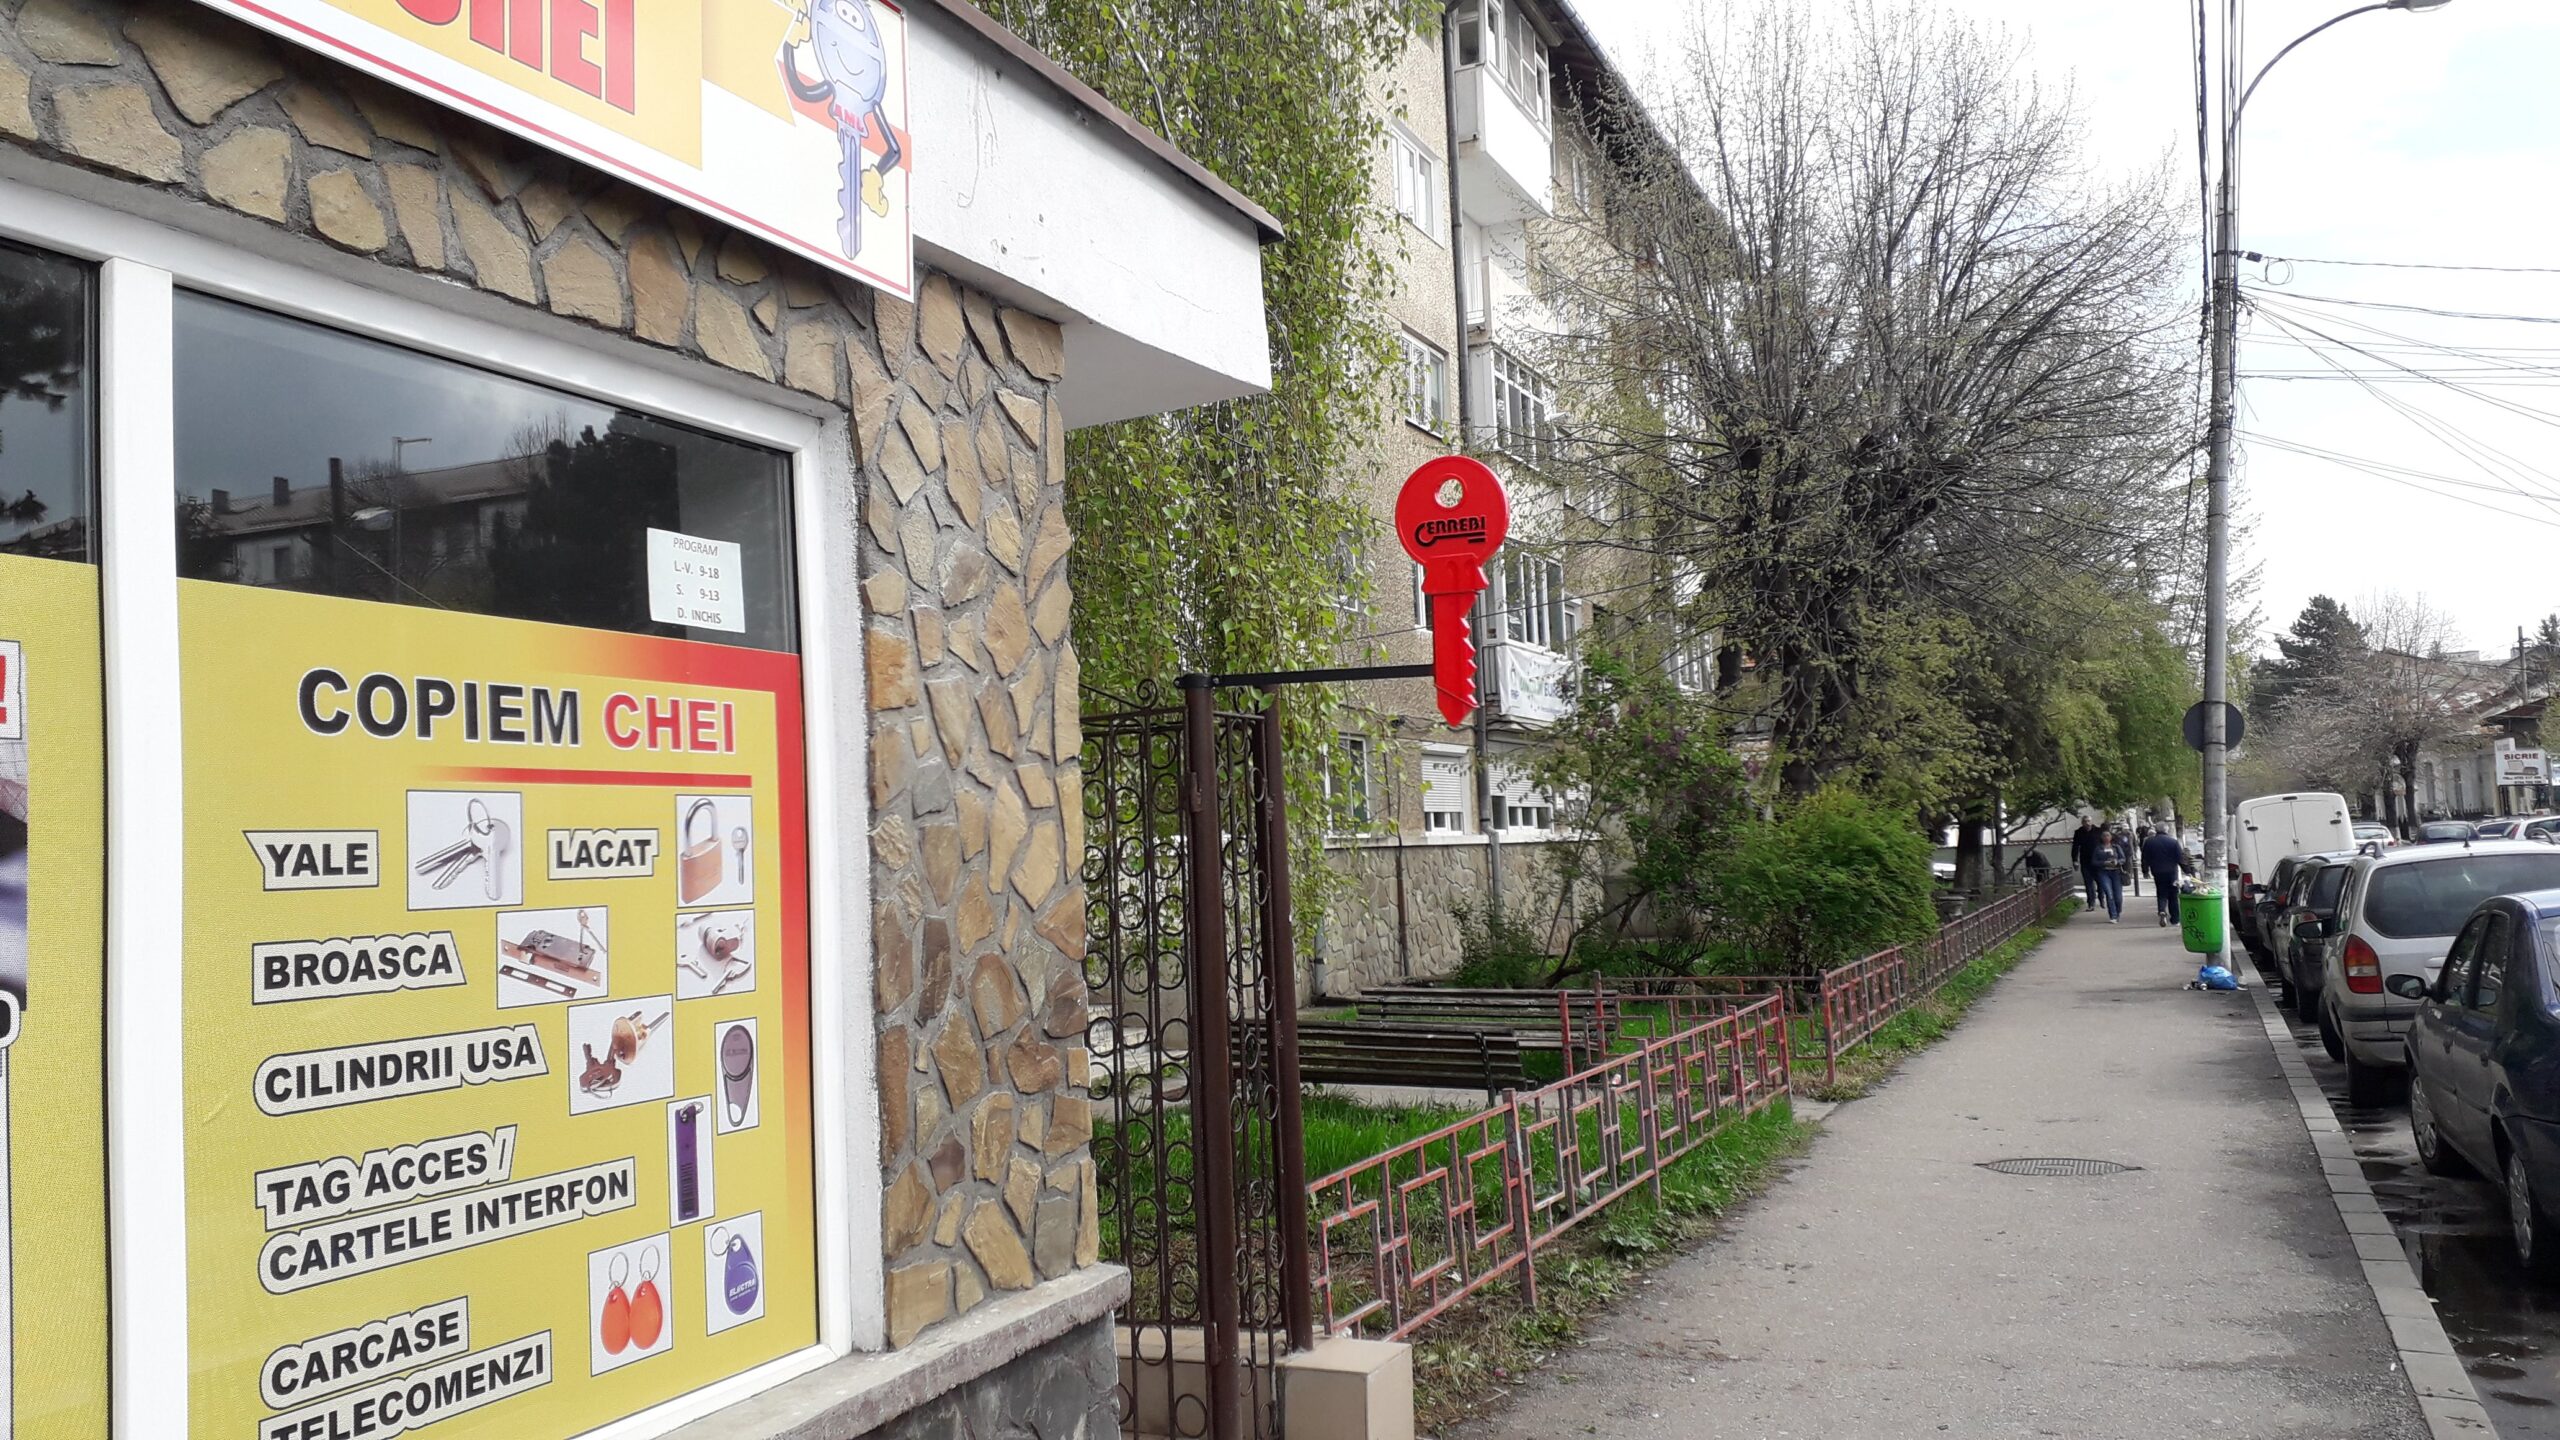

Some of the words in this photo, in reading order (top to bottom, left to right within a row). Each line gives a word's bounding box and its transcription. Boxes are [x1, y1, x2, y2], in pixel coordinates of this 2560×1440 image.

[673, 538, 718, 556] PROGRAM
[674, 560, 694, 575] L-V.
[699, 565, 720, 579] 9-18
[676, 584, 684, 596] S.
[699, 588, 720, 601] 9-13
[677, 607, 688, 619] D.
[691, 609, 722, 624] INCHIS
[299, 668, 582, 746] COPIEM
[603, 694, 735, 754] CHEI
[264, 842, 369, 877] YALE
[555, 839, 652, 869] LACAT
[263, 943, 452, 990] BROASCA
[264, 1047, 454, 1103] CILINDRII
[467, 1036, 537, 1074] USA
[267, 1169, 350, 1215] TAG
[366, 1144, 488, 1197] ACCES
[270, 1209, 452, 1282] CARTELE
[465, 1170, 629, 1234] INTERFON
[271, 1312, 460, 1396] CARCASE
